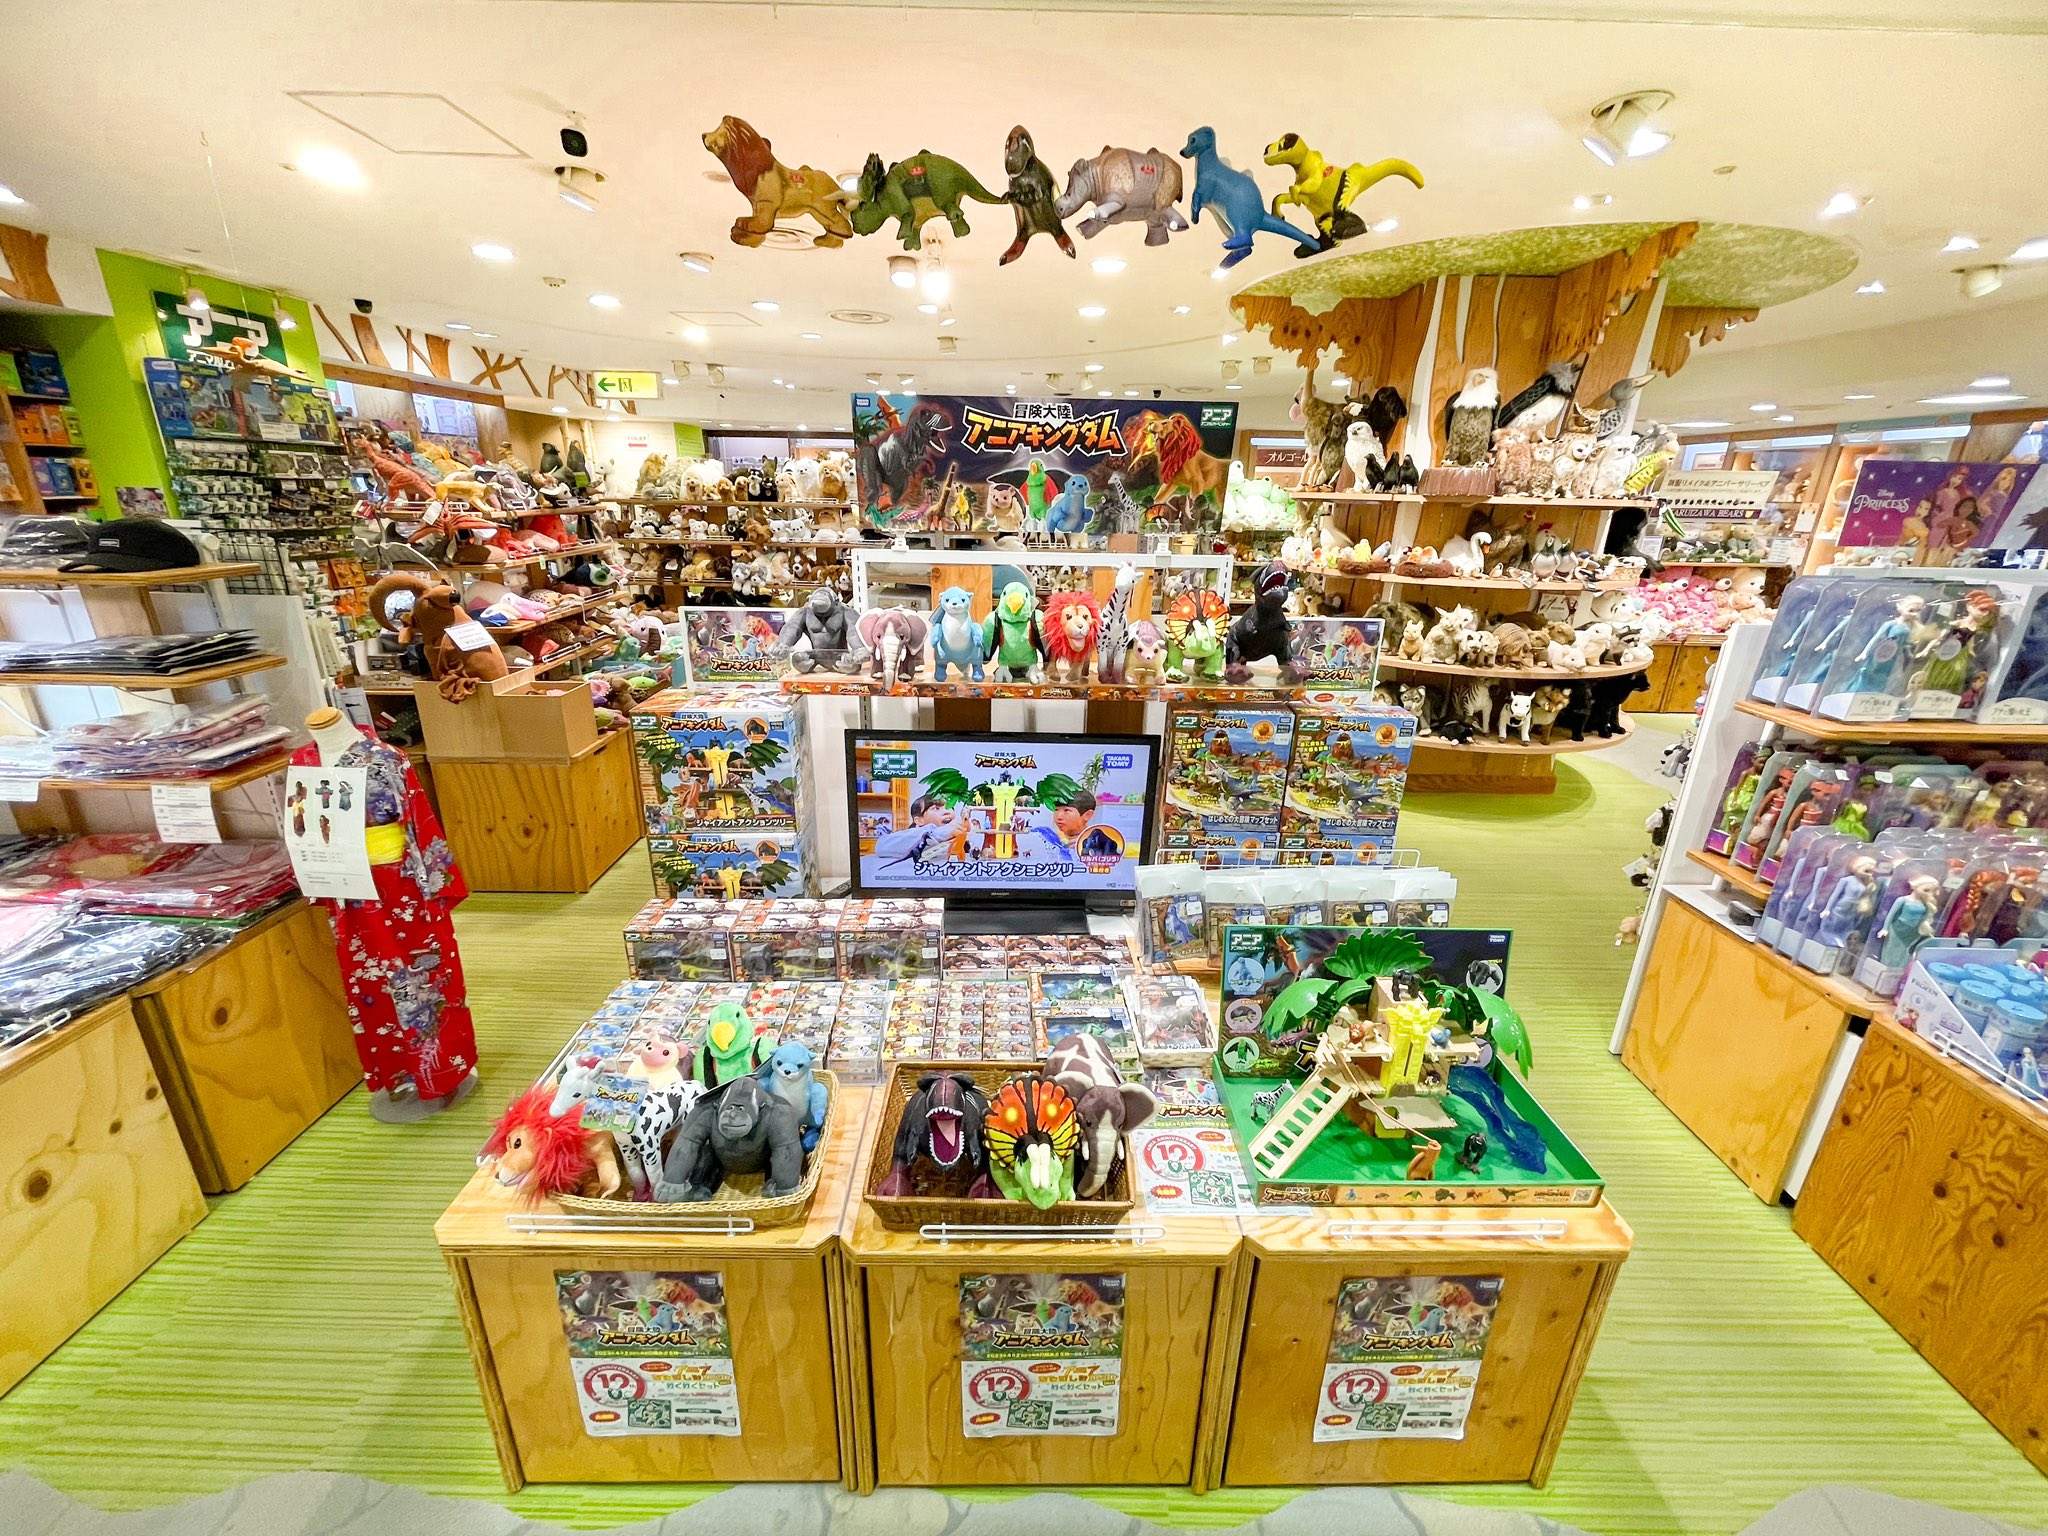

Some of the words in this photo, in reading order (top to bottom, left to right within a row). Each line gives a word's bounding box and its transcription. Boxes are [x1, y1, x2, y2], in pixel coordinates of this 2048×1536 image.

[1014, 404, 1073, 419] 冒険大陸
[1202, 408, 1232, 421] アニア
[964, 408, 1126, 455] アニアキングダム
[1853, 494, 1911, 513] PRINCESS
[1671, 508, 1715, 518] ARUIZAWA
[1717, 508, 1745, 518] BEARS
[632, 716, 657, 725] アニア
[661, 715, 728, 732] アニアキングダム
[1176, 716, 1198, 725] アニア
[873, 753, 915, 769] アニア
[975, 754, 1037, 768] アニアキングダム
[695, 818, 794, 827] ジャイアントアクションツリー
[914, 862, 1086, 877] ジャイアントアクションツリー
[1231, 933, 1263, 945] アニア
[599, 1329, 697, 1346] アニアキングダム
[993, 1331, 1090, 1348] アニアキングダム
[1360, 1332, 1455, 1350] アニアキングダム
